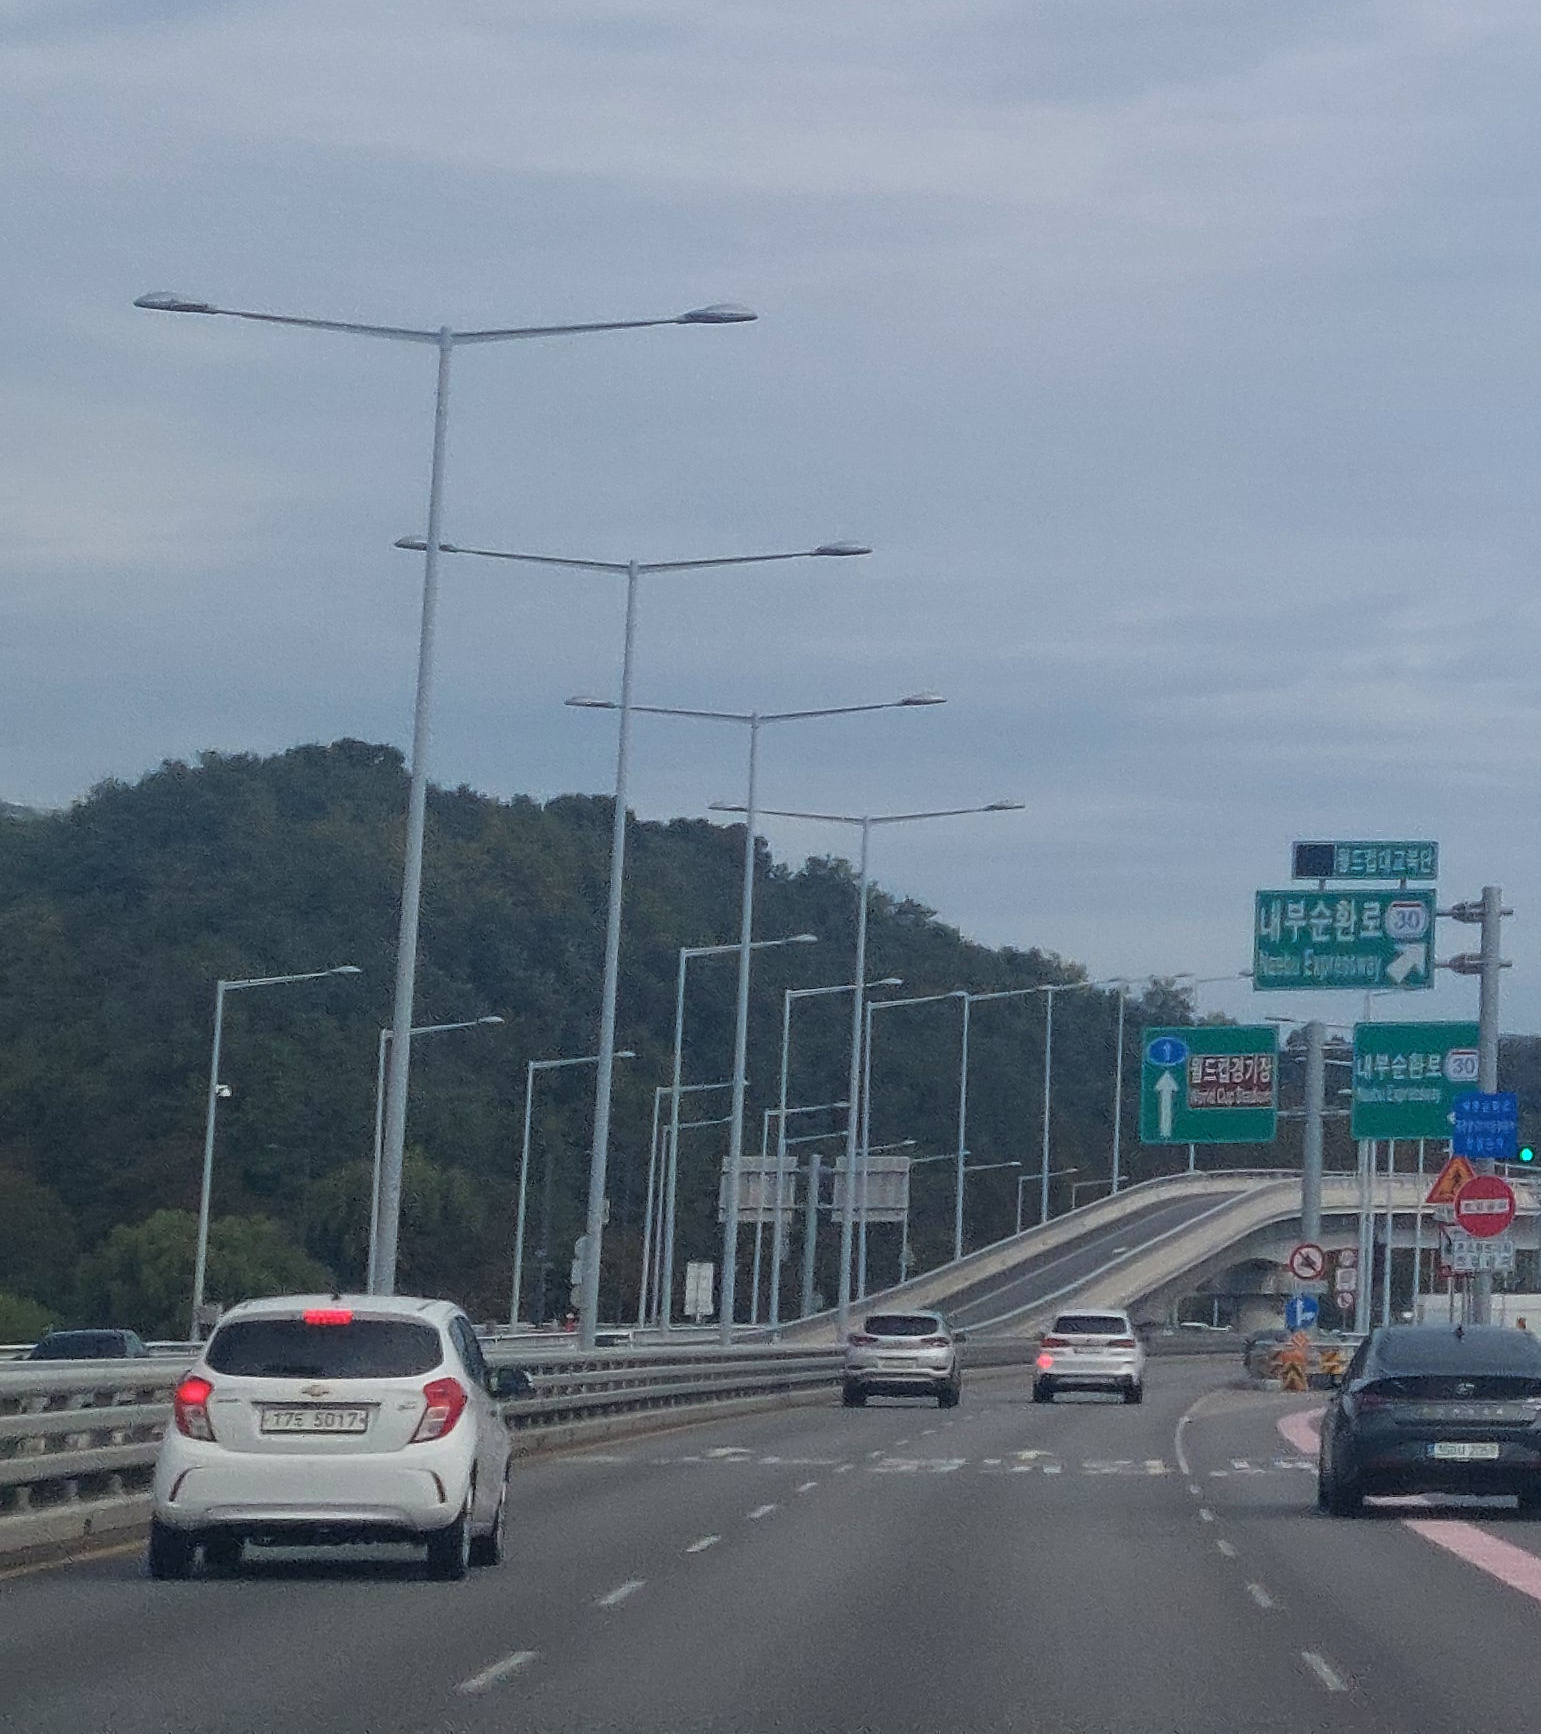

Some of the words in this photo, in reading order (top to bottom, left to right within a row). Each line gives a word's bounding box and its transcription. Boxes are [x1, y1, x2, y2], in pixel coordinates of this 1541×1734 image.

[1260, 899, 1383, 944] 내부순환로
[1395, 909, 1421, 929] 30
[1190, 1054, 1272, 1084] 월드컵경기장
[1357, 1052, 1442, 1081] 내부순환로
[1452, 1057, 1476, 1075] 30
[313, 1412, 359, 1428] 5017
